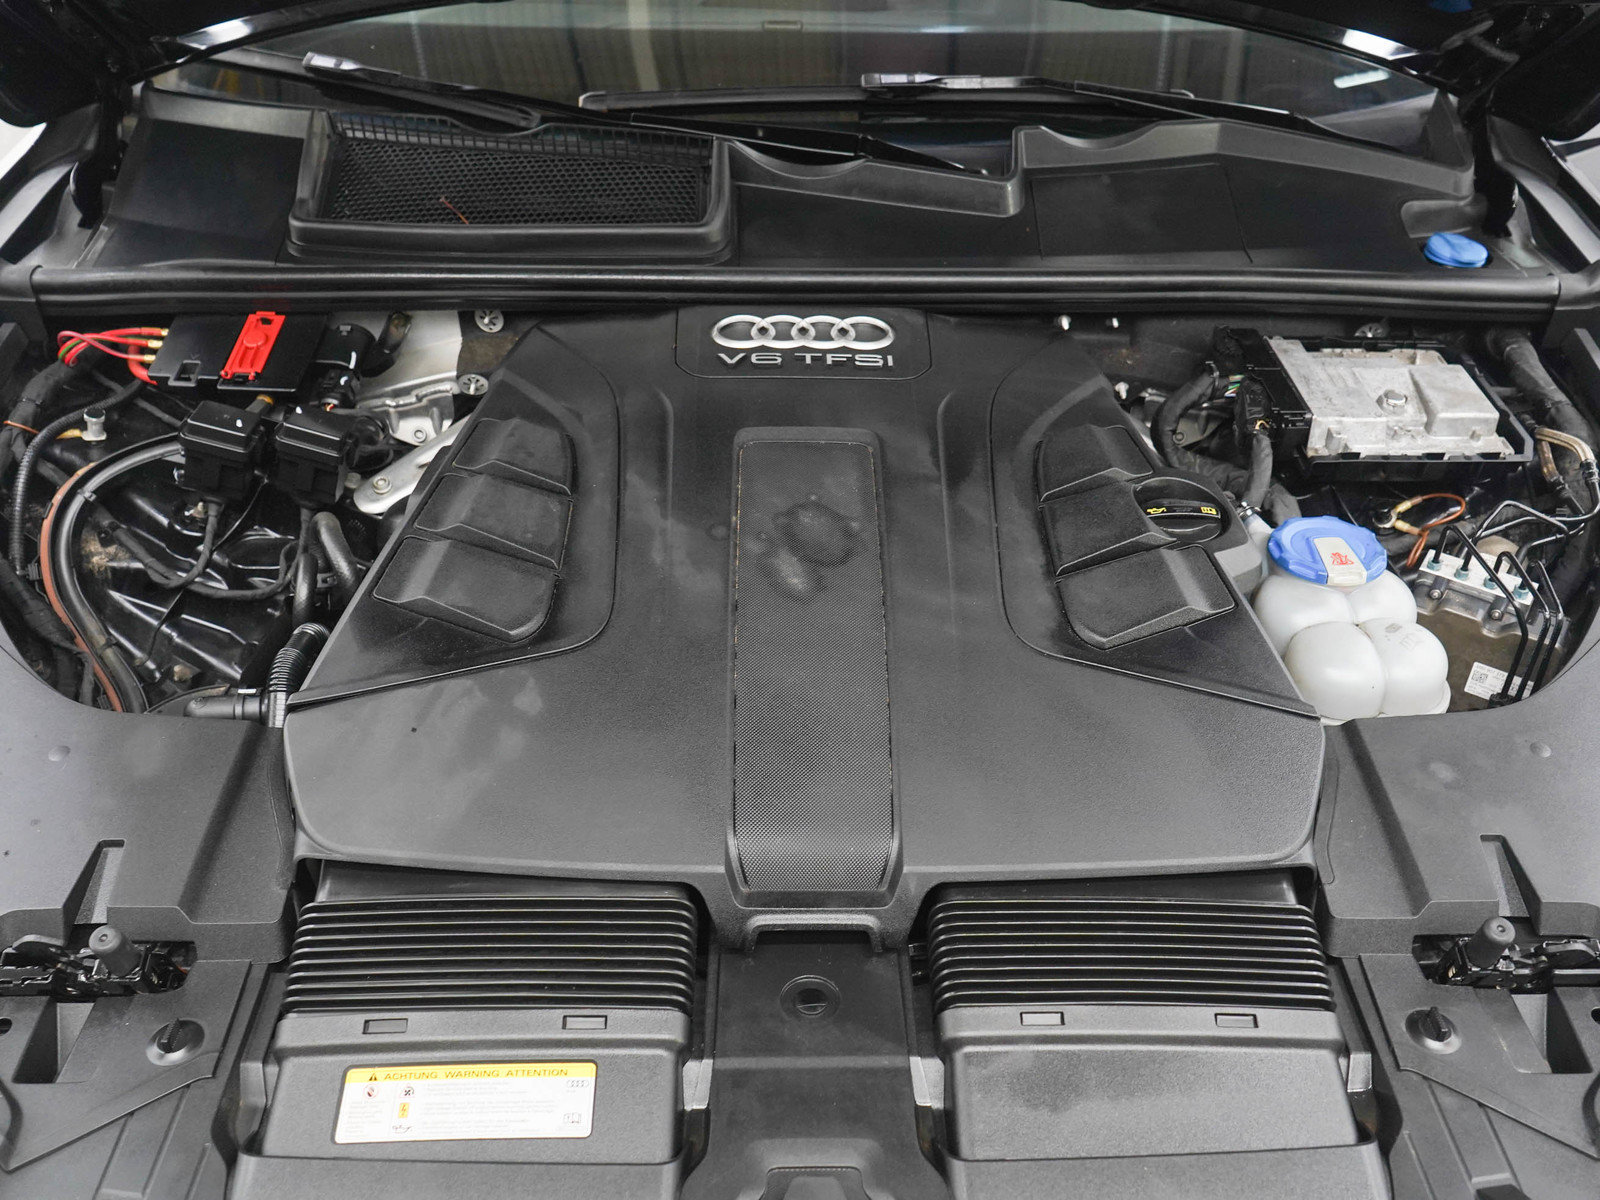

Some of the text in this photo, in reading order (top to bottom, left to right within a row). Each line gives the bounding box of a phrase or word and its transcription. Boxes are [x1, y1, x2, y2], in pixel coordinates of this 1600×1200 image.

[717, 352, 894, 367] V6 TFSI
[384, 1068, 568, 1081] ACHTUNG WARNING ATTENTION
